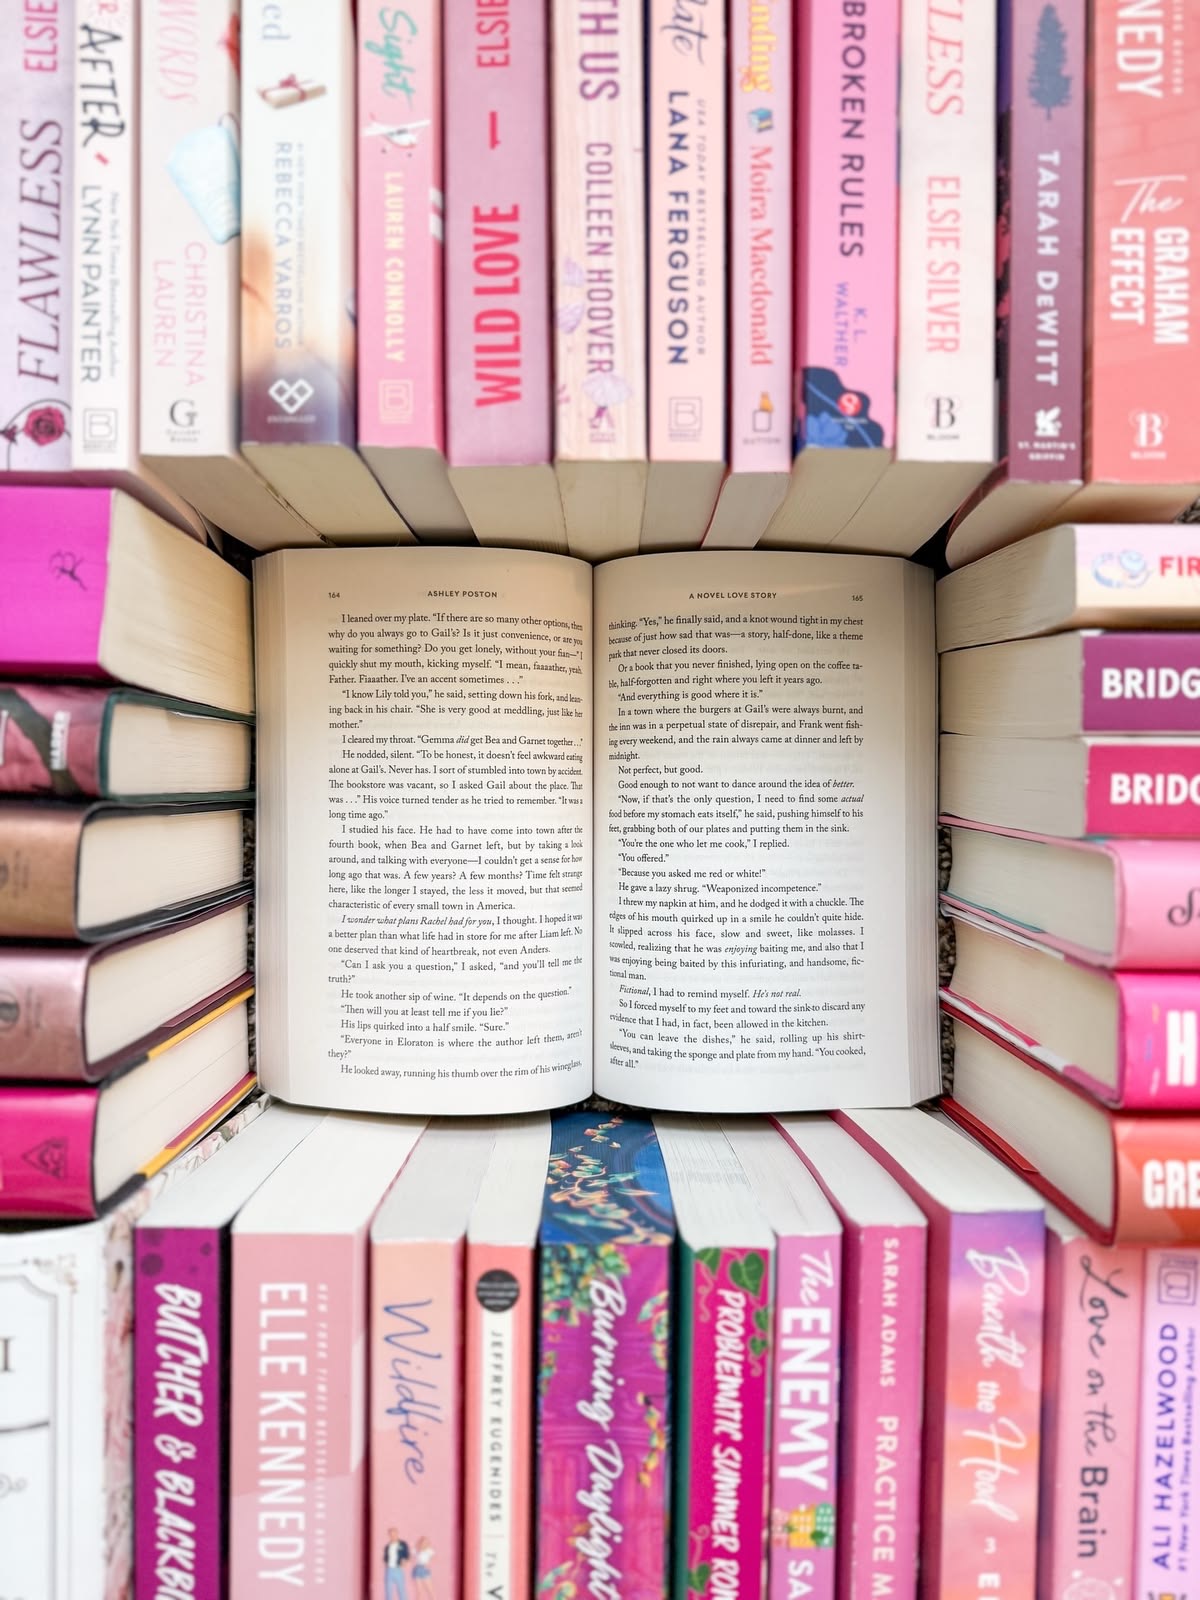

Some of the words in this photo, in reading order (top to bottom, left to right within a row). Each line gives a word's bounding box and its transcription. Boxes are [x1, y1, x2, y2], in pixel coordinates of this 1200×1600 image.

[79, 23, 126, 148] AFTER
[364, 8, 418, 104] Sight
[579, 52, 620, 101] US
[841, 0, 867, 140] BROKEN
[926, 0, 964, 116] LESS
[1116, 0, 1163, 98] NEDY
[667, 91, 689, 175] LANA
[697, 99, 706, 126] USA
[697, 135, 706, 182] TODAY
[80, 185, 103, 255] LYNN
[109, 192, 119, 214] New
[109, 218, 119, 239] York
[275, 142, 293, 247] REBECCA
[385, 171, 404, 250] LAUREN
[586, 142, 612, 257] COLLEEN
[750, 146, 773, 220] Moira
[840, 154, 865, 258] RULES
[927, 176, 960, 250] ELSIE
[1037, 151, 1061, 256] TARAH
[1115, 175, 1188, 225] The
[18, 119, 63, 384] FLAWLESS
[109, 245, 119, 274] Times
[473, 204, 520, 296] LOVE
[667, 191, 689, 365] FERGUSON
[697, 188, 706, 287] BESTSELLING
[1109, 227, 1146, 326] EFFECT
[81, 263, 102, 383] PAINTER
[152, 260, 176, 368] LAUREN
[184, 242, 206, 387] CHRISTINA
[275, 258, 292, 350] YARROS
[385, 258, 405, 362] CONNOLLY
[586, 268, 614, 374] HOOVER
[697, 295, 706, 356] AUTHOR
[750, 228, 774, 366] Macdonald
[834, 282, 848, 367] WALTHER
[926, 258, 960, 354] SILVER
[1153, 227, 1190, 345] GRAHAM
[475, 308, 522, 408] WILD
[1101, 667, 1200, 700] BRIDG
[51, 711, 69, 771] HARPER
[618, 766, 632, 774] Not
[633, 765, 662, 776] perfect,
[664, 765, 678, 773] but
[680, 764, 703, 776] good.
[329, 810, 347, 821] long
[348, 810, 366, 819] time
[368, 810, 388, 821] ago.”
[328, 899, 380, 909] characteristic
[382, 900, 392, 909] of
[393, 904, 415, 912] every
[417, 901, 439, 910] small
[466, 902, 474, 910] in
[476, 901, 515, 910] America.
[344, 944, 378, 954] deserved
[381, 946, 397, 955] that
[400, 946, 418, 955] kind
[421, 946, 431, 955] of
[432, 947, 479, 956] heartbreak,
[520, 945, 550, 954] Anders.
[610, 1013, 636, 1024] evidence
[637, 1016, 653, 1025] that
[656, 1017, 659, 1026] I
[662, 1018, 680, 1028] had,
[682, 1020, 690, 1028] in
[693, 1019, 711, 1030] fact,
[714, 1020, 734, 1028] been
[736, 1019, 768, 1028] allowed
[771, 1020, 779, 1028] in
[781, 1018, 796, 1027] the
[797, 1018, 828, 1027] kitchen.
[1142, 1160, 1200, 1209] GRE
[800, 1248, 833, 1307] The
[881, 1237, 900, 1308] SARAH
[965, 1245, 1031, 1370] Beneath
[1078, 1254, 1129, 1360] Love
[153, 1282, 209, 1427] BUTCHER
[259, 1282, 308, 1376] ELLE
[490, 1330, 504, 1409] JEFFREY
[576, 1272, 627, 1432] Burning
[711, 1288, 747, 1442] PROBLEMATIC
[879, 1313, 897, 1388] ADAMS
[383, 1298, 443, 1485] Wildfire
[777, 1307, 832, 1491] ENEMY
[976, 1380, 998, 1414] the
[1082, 1405, 1117, 1457] the
[1083, 1371, 1106, 1397] on
[1154, 1323, 1179, 1512] HAZELWOOD
[1181, 1375, 1196, 1445] Bestselling
[153, 1433, 197, 1464] &
[257, 1391, 306, 1587] KENNEDY
[489, 1417, 503, 1523] EUGENIDES
[871, 1415, 899, 1562] PRACTICE
[959, 1415, 1028, 1523] Hood
[1180, 1450, 1192, 1485] Times
[575, 1438, 625, 1600] Daylight
[710, 1442, 743, 1554] SUMMER
[1077, 1466, 1109, 1560] Brain
[1179, 1525, 1190, 1552] New
[1180, 1490, 1191, 1516] York
[1152, 1524, 1172, 1571] ALI
